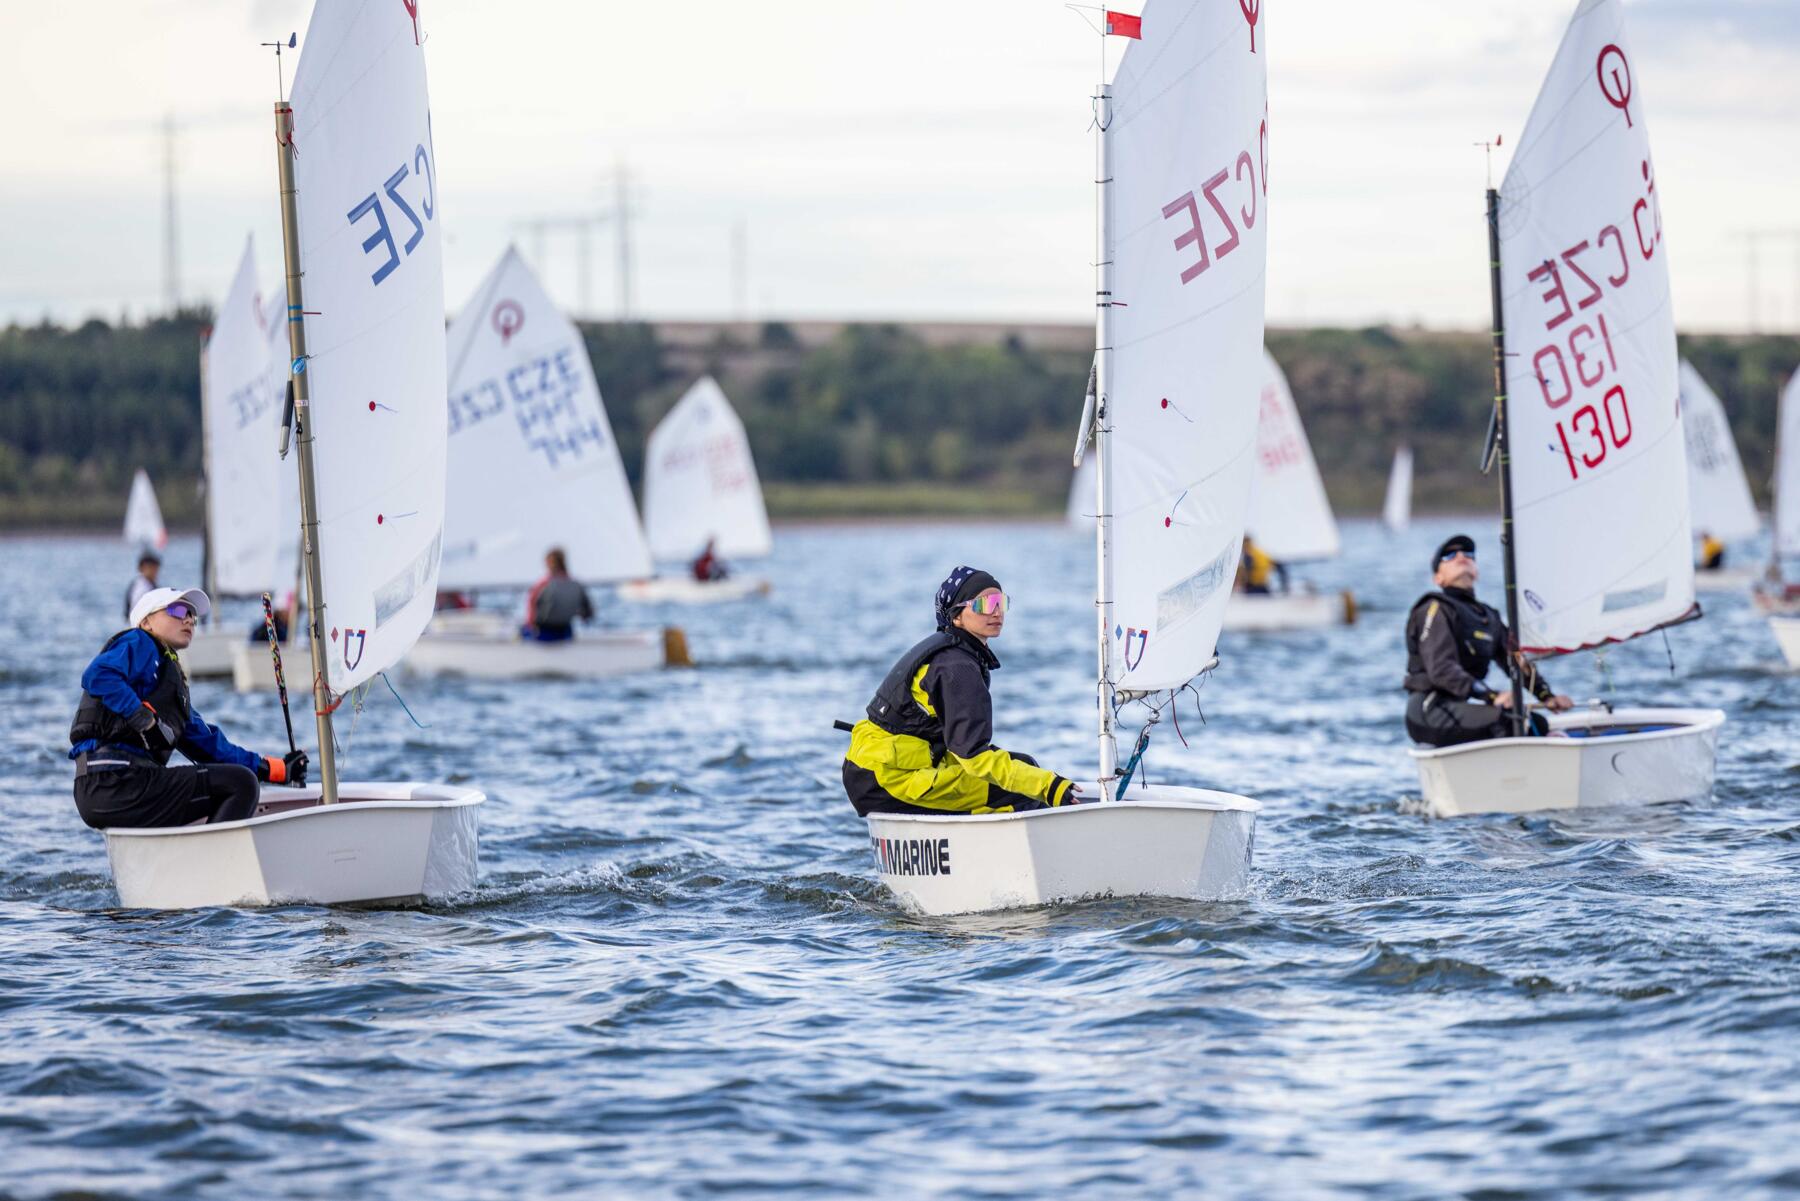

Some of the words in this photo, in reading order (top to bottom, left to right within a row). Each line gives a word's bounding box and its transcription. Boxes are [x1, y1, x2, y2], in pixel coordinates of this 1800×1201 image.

[506, 348, 577, 402] CZE
[529, 416, 605, 470] 744
[1555, 384, 1632, 480] 130
[886, 838, 951, 876] MARINE
